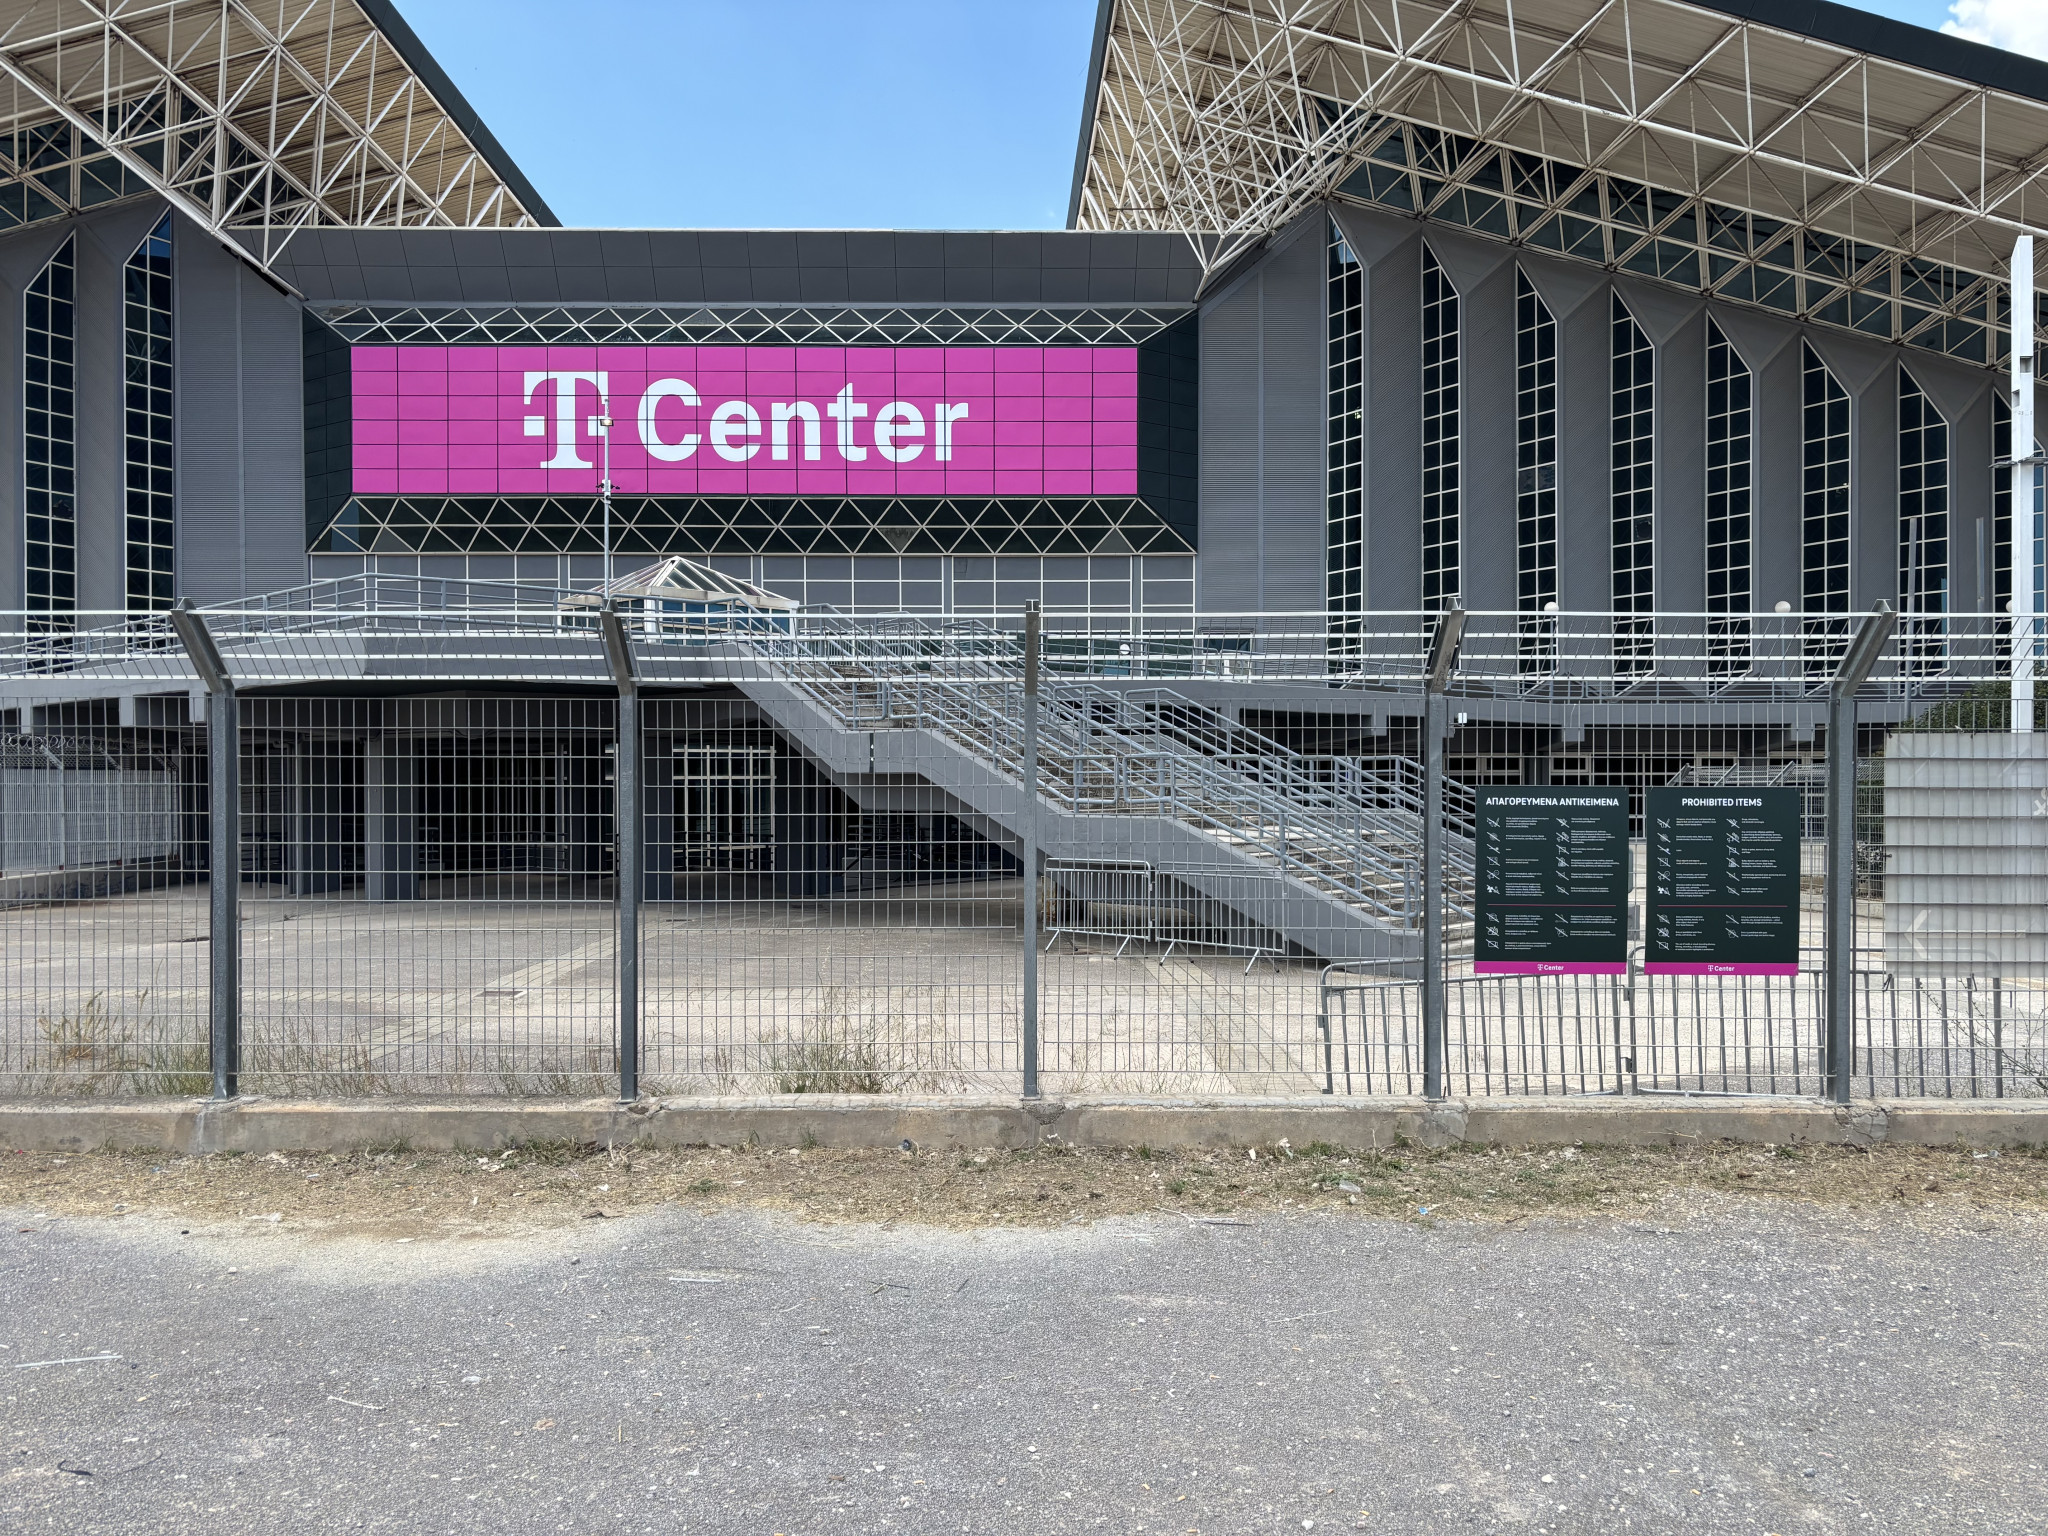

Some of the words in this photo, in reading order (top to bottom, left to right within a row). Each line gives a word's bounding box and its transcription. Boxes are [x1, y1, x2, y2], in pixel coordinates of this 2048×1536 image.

[637, 378, 968, 463] Center
[1486, 797, 1558, 806] ΑΠΑΓΟΡΕΥΜΕΝΑ
[1559, 797, 1619, 807] ΑΝΤΙΚΕΙΜΕΝΑ
[1682, 798, 1734, 807] PROHIBITED
[1735, 798, 1762, 807] ITEMS
